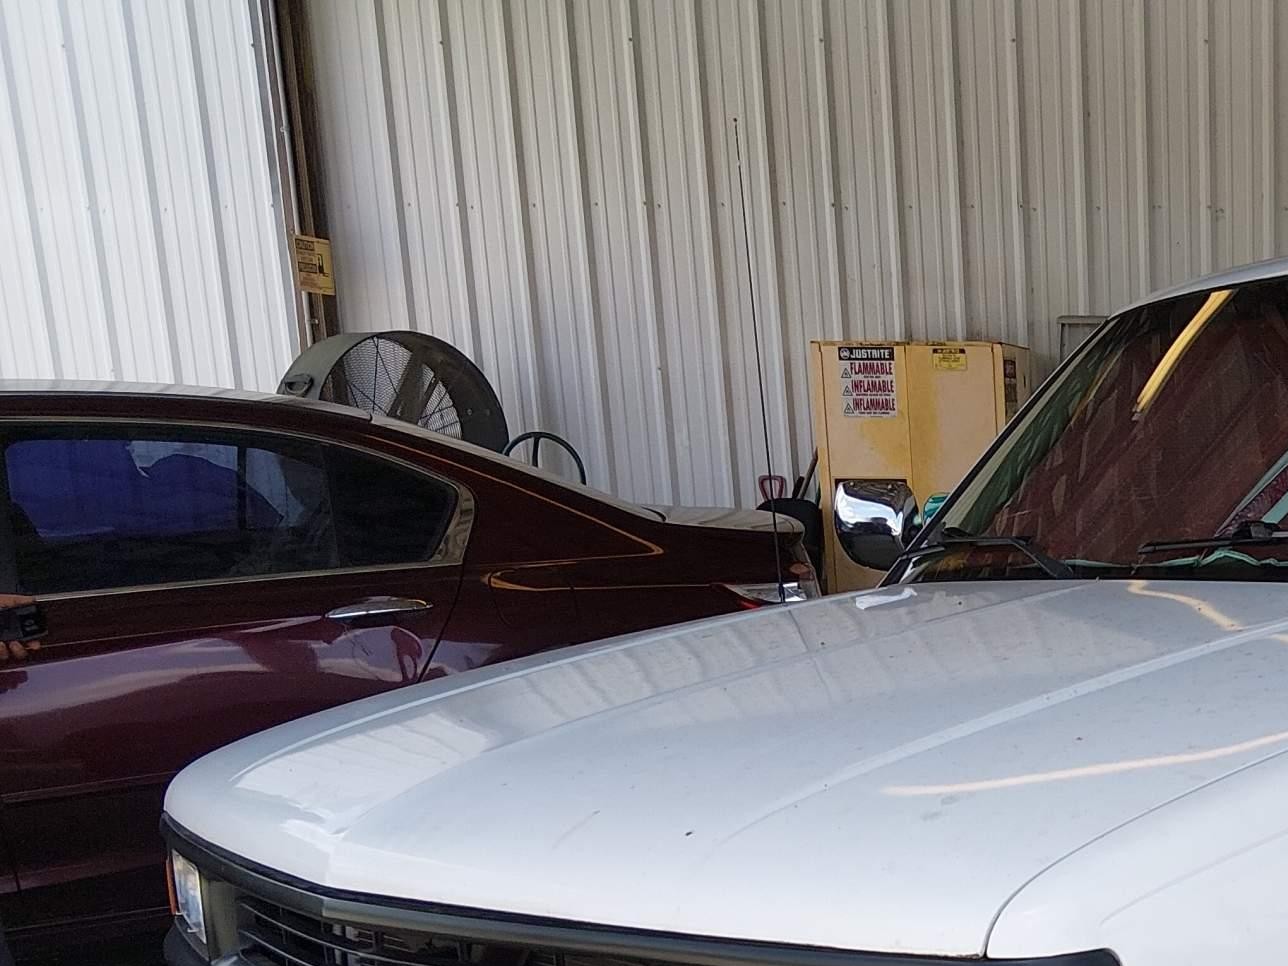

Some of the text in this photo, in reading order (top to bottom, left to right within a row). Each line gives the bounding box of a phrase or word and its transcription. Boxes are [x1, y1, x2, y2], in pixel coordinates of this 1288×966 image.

[851, 349, 890, 358] JUSTRITE
[850, 362, 893, 375] FLAMMABLE
[852, 380, 894, 393] INFLAMABLE
[853, 398, 896, 411] INFLAMMABLE
